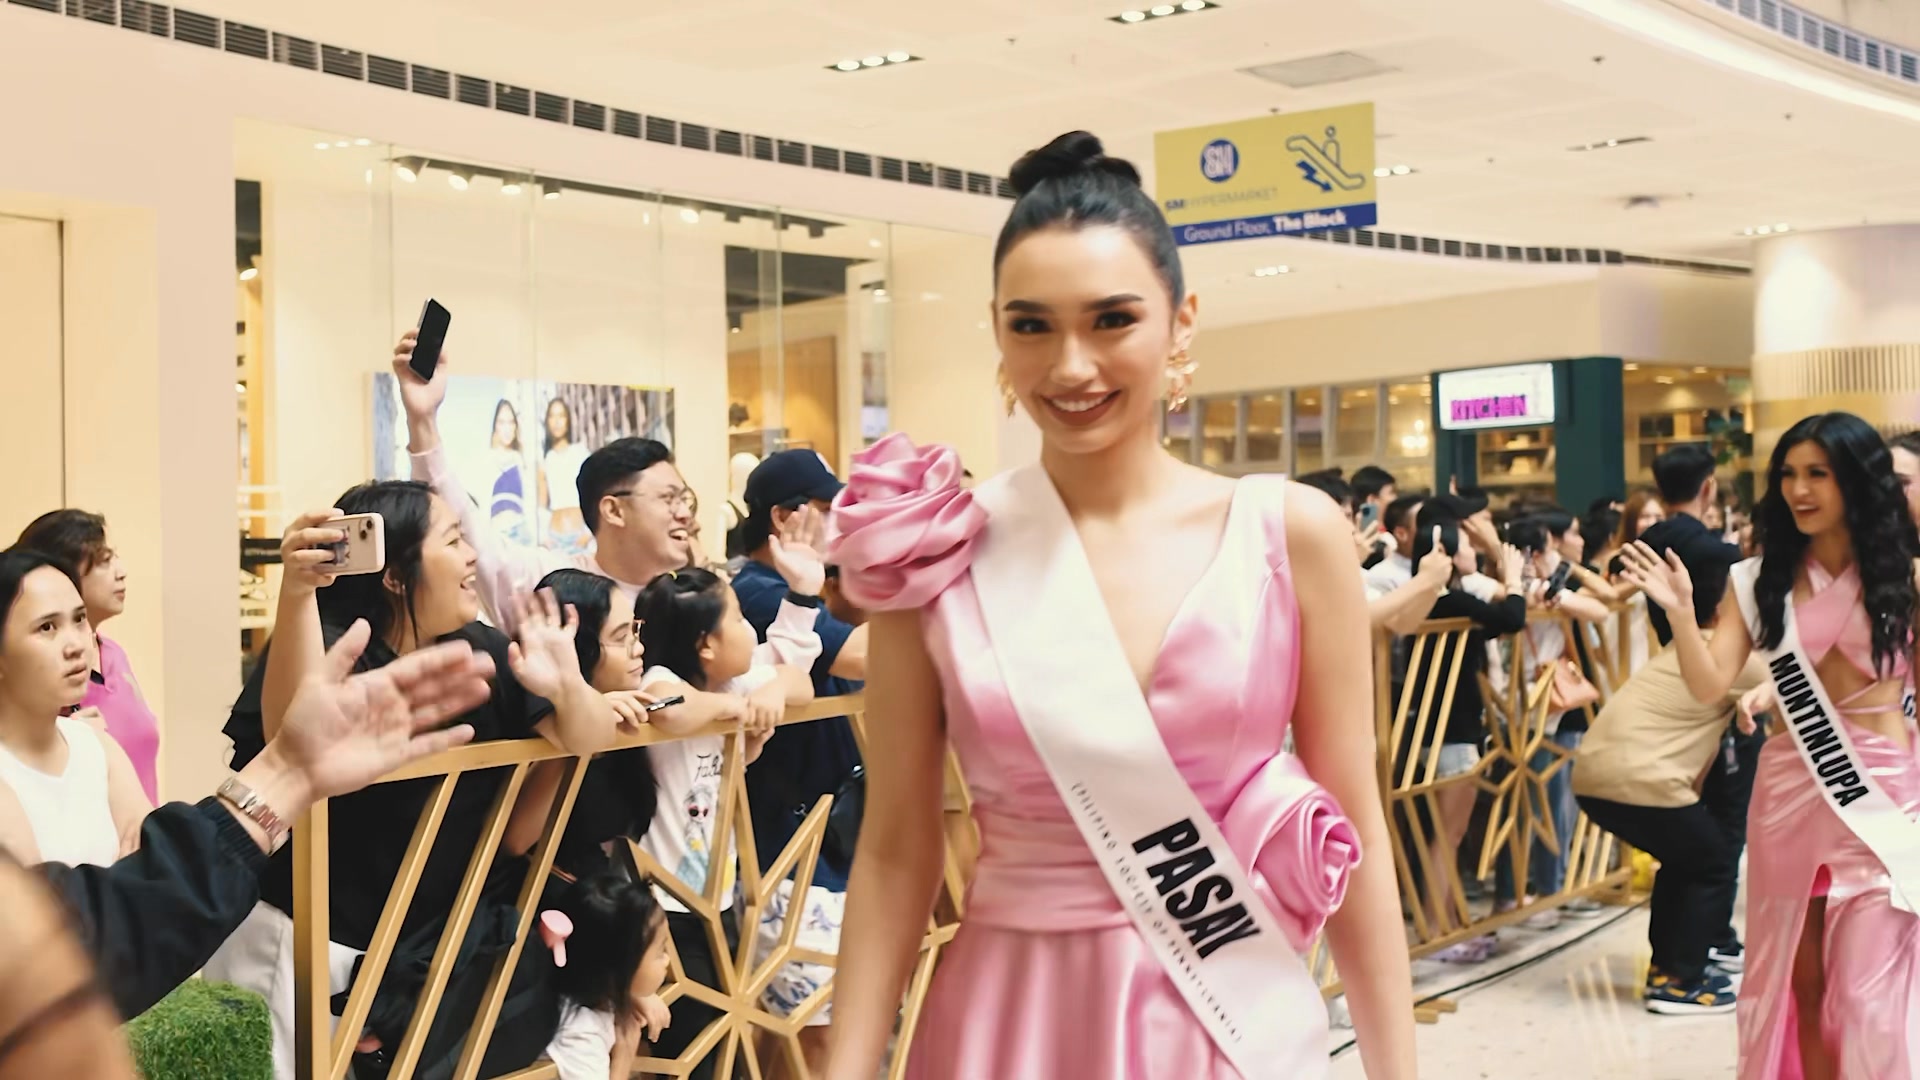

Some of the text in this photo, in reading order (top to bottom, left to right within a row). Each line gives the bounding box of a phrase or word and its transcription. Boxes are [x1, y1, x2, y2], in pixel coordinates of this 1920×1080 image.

[1202, 143, 1235, 179] SM
[1183, 223, 1233, 243] Ground
[1272, 214, 1302, 232] The
[1303, 208, 1347, 230] Block
[1769, 652, 1870, 808] MUNTINLUPA
[1131, 817, 1262, 960] PASAY
